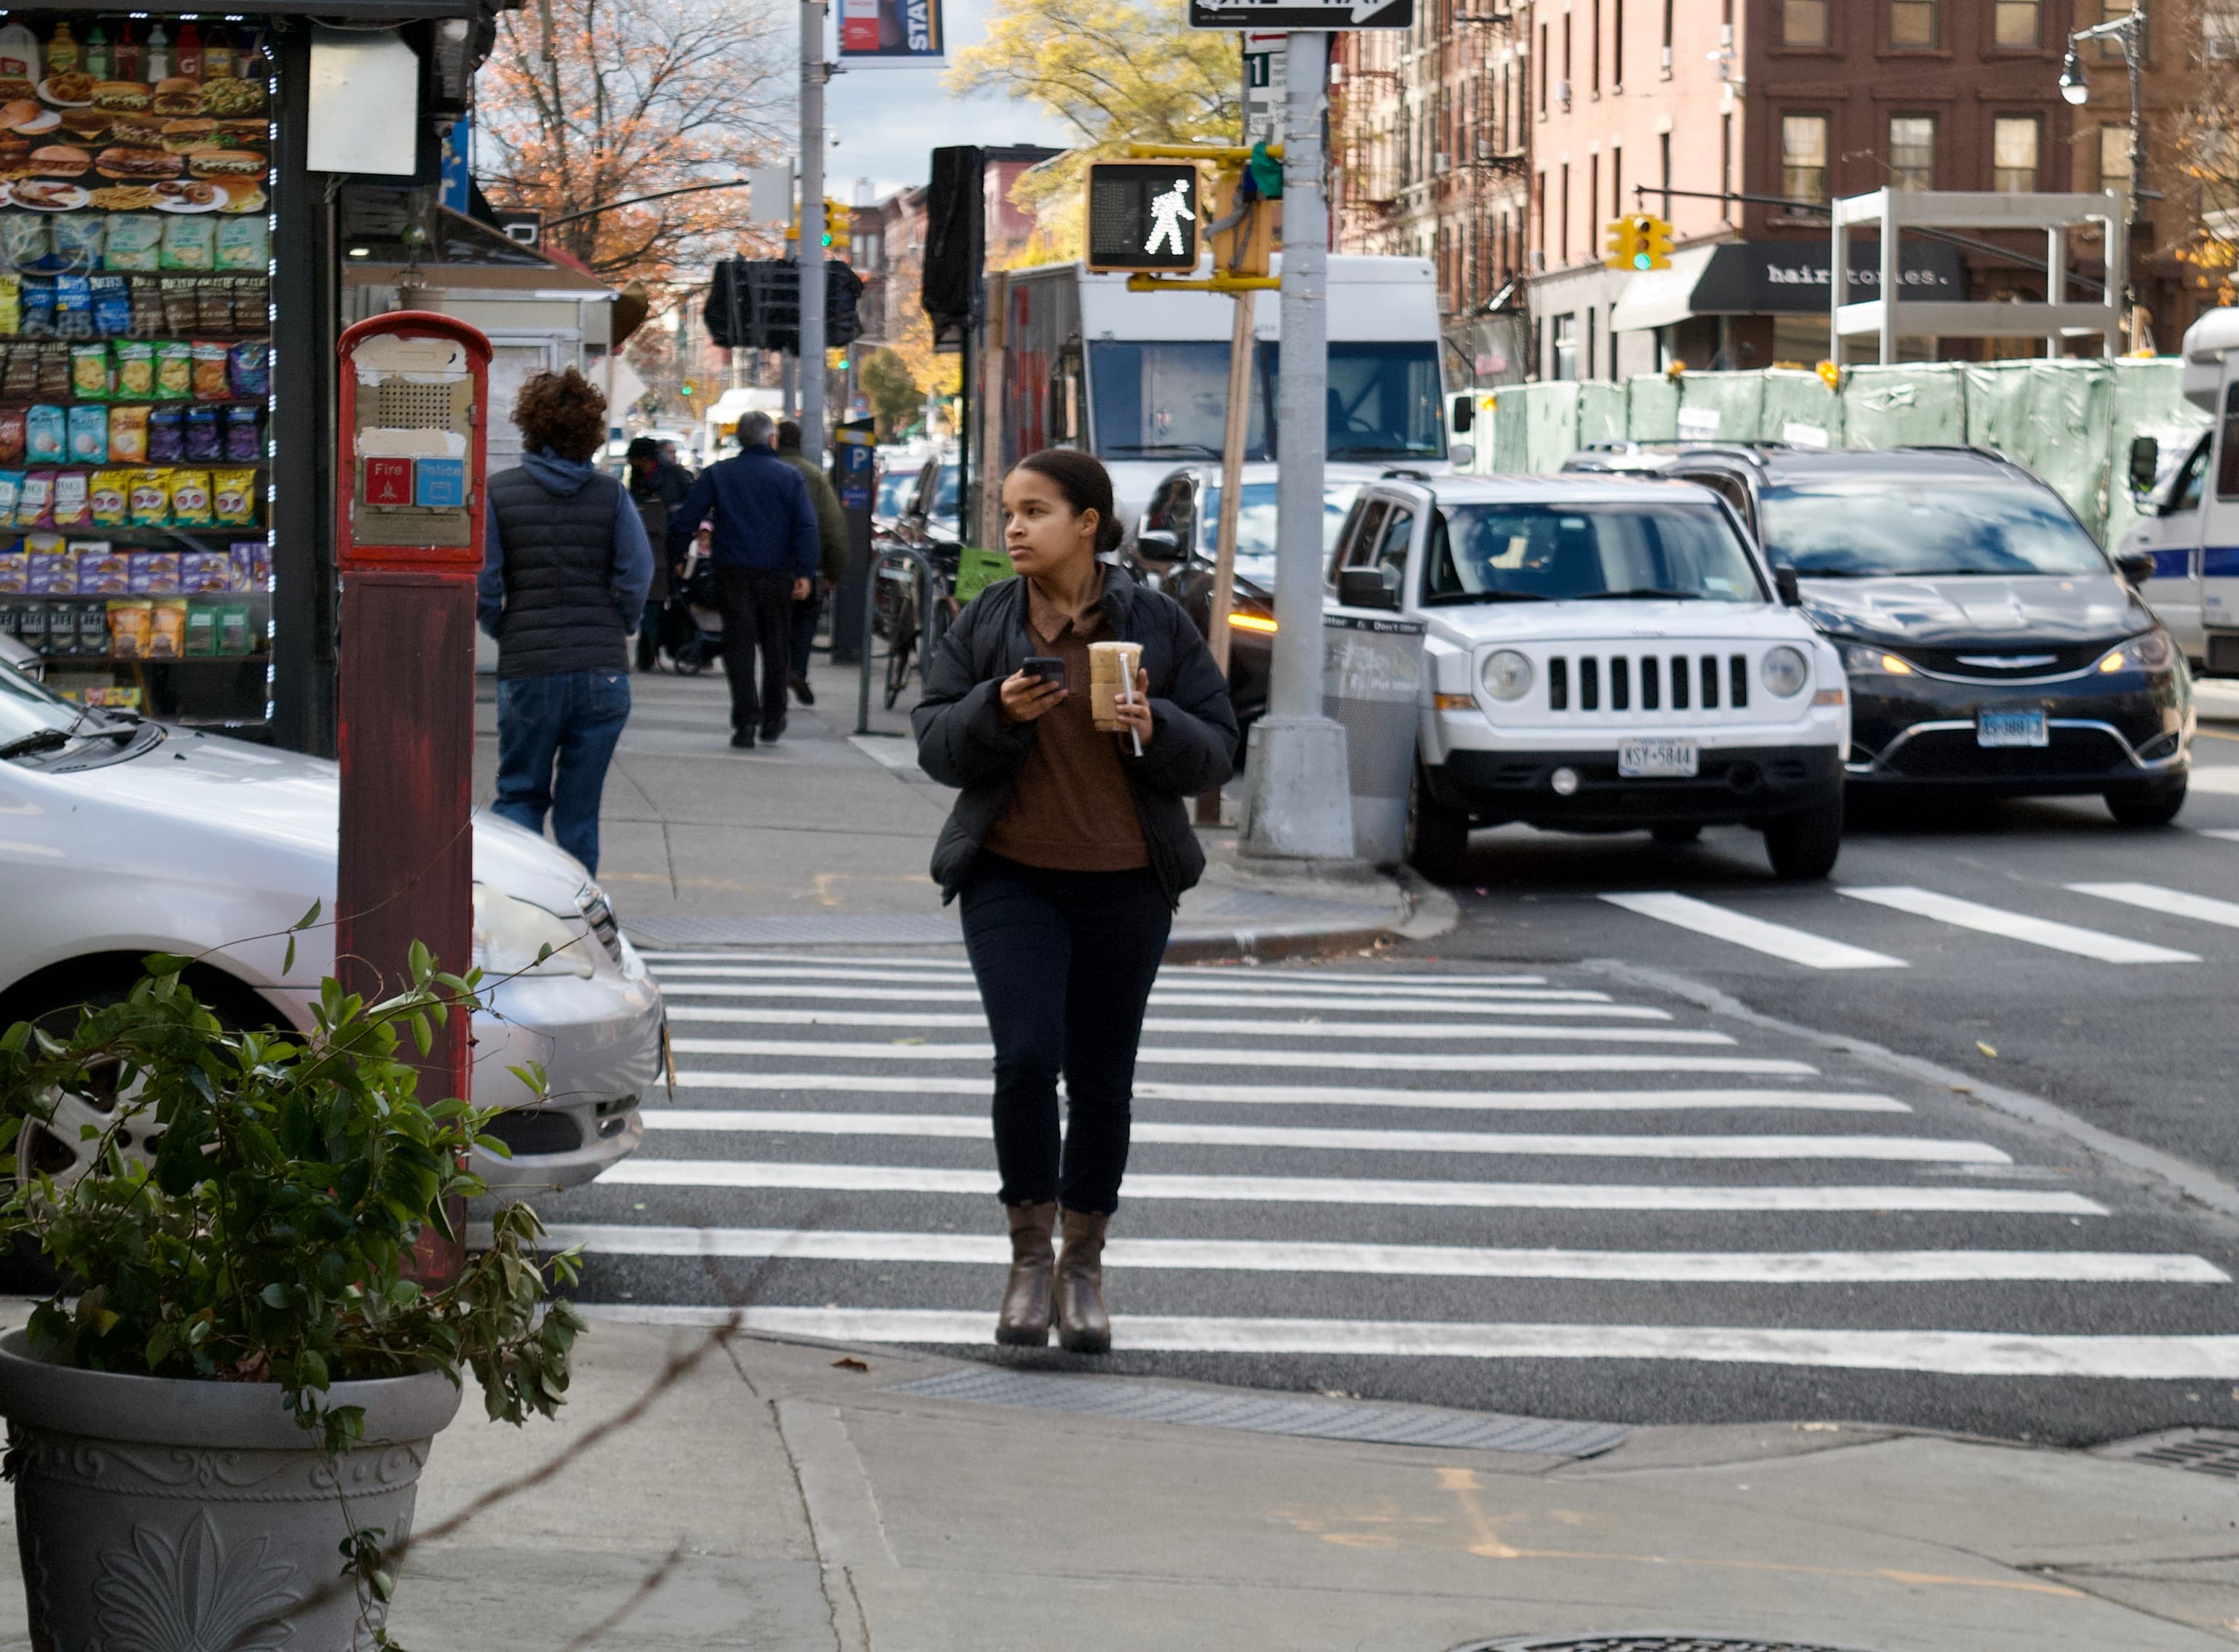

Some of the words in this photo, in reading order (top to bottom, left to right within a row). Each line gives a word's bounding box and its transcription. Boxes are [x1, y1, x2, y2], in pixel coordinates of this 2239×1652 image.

[181, 59, 194, 73] G
[1251, 56, 1262, 85] 1
[852, 447, 867, 470] P
[374, 463, 402, 476] Fire
[418, 464, 461, 477] Police
